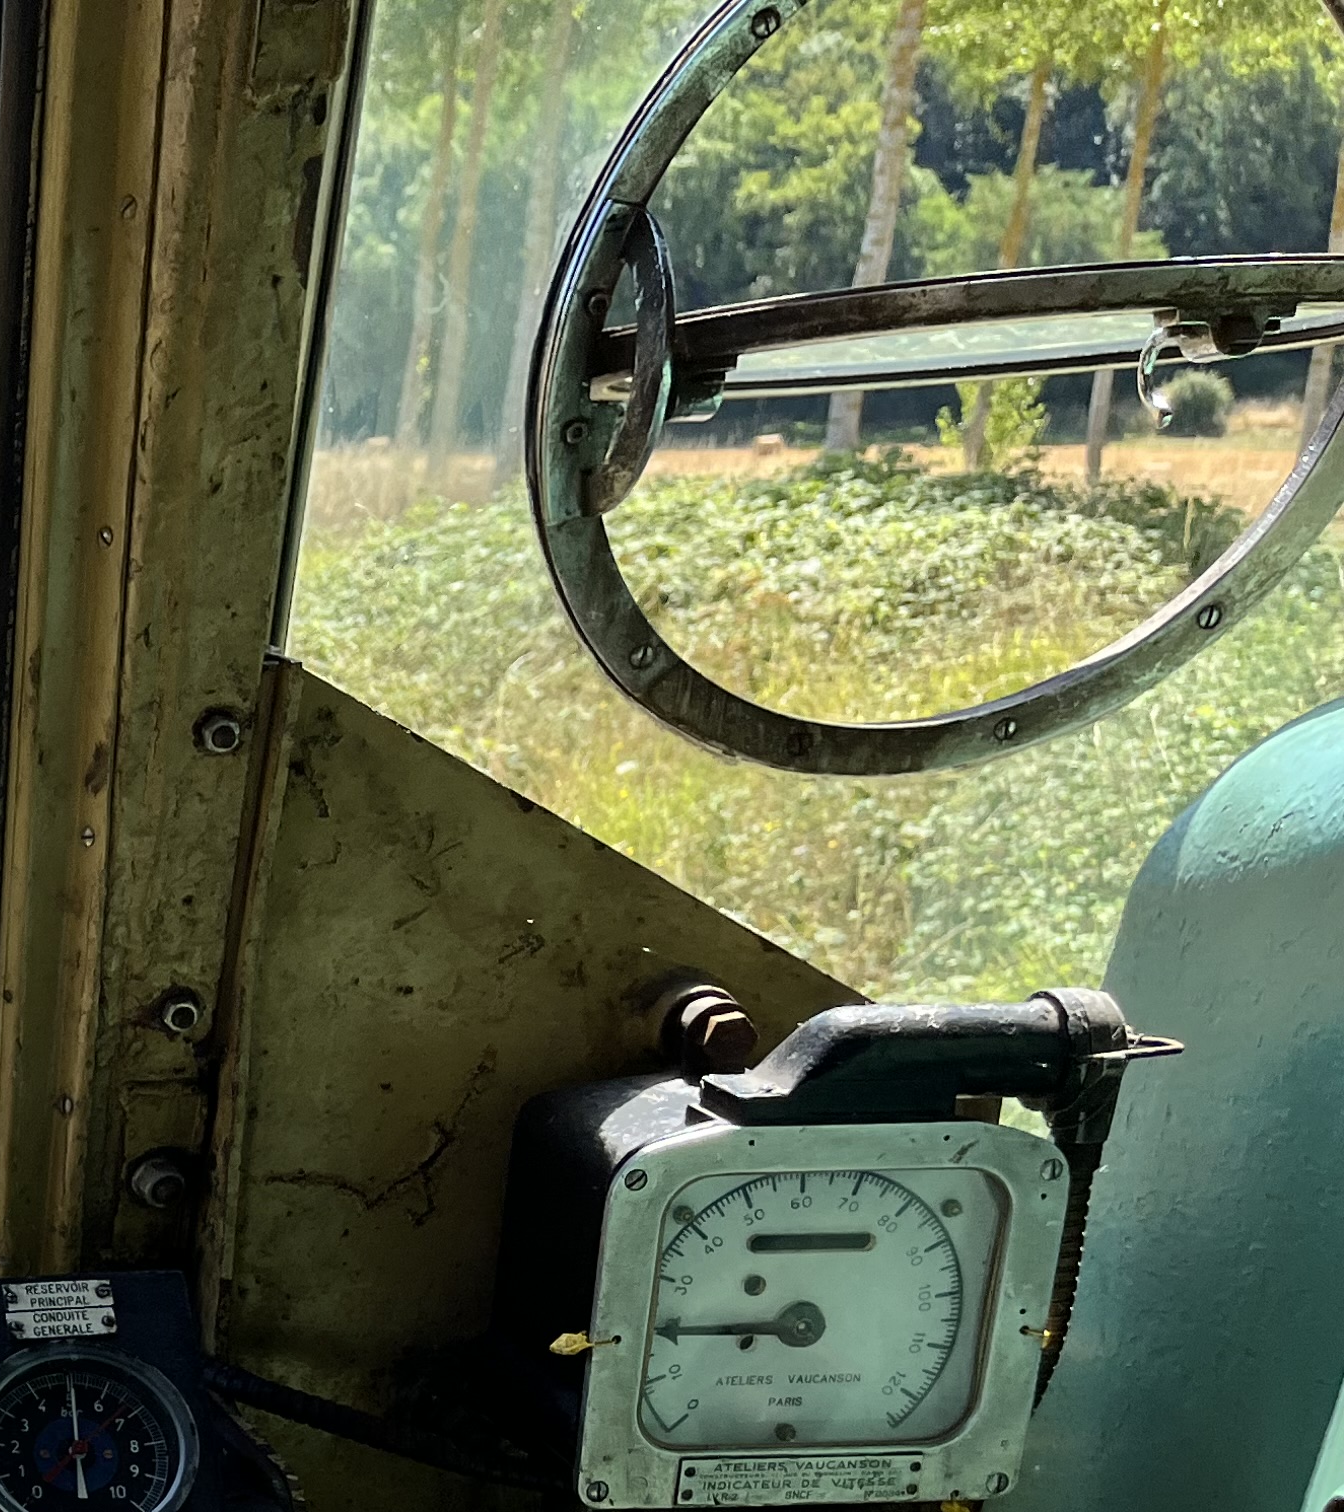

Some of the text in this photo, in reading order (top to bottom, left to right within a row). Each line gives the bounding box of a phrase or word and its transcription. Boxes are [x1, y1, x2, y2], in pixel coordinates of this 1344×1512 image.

[790, 1197, 813, 1210] 60
[838, 1198, 860, 1214] 70
[744, 1209, 766, 1227] 50
[703, 1236, 724, 1256] 40
[25, 1283, 89, 1296] RESERVOIR
[29, 1295, 89, 1307] PRINCIPAL
[33, 1310, 89, 1323] CONDUITE
[34, 1323, 95, 1335] GENERALE
[716, 1372, 861, 1386] ATELIERS VAUCANSON
[38, 1400, 46, 1413] 4
[94, 1401, 103, 1412] 6
[768, 1396, 803, 1407] PARIS
[20, 1419, 29, 1432] 3
[114, 1419, 125, 1431] 7
[11, 1440, 20, 1454] 2
[129, 1440, 139, 1453] 8
[129, 1465, 139, 1478] 9
[714, 1460, 892, 1472] ATELIERS VAUCANSON
[702, 1478, 897, 1490] INDICATEUR DE VITESSE
[109, 1485, 126, 1499] 10
